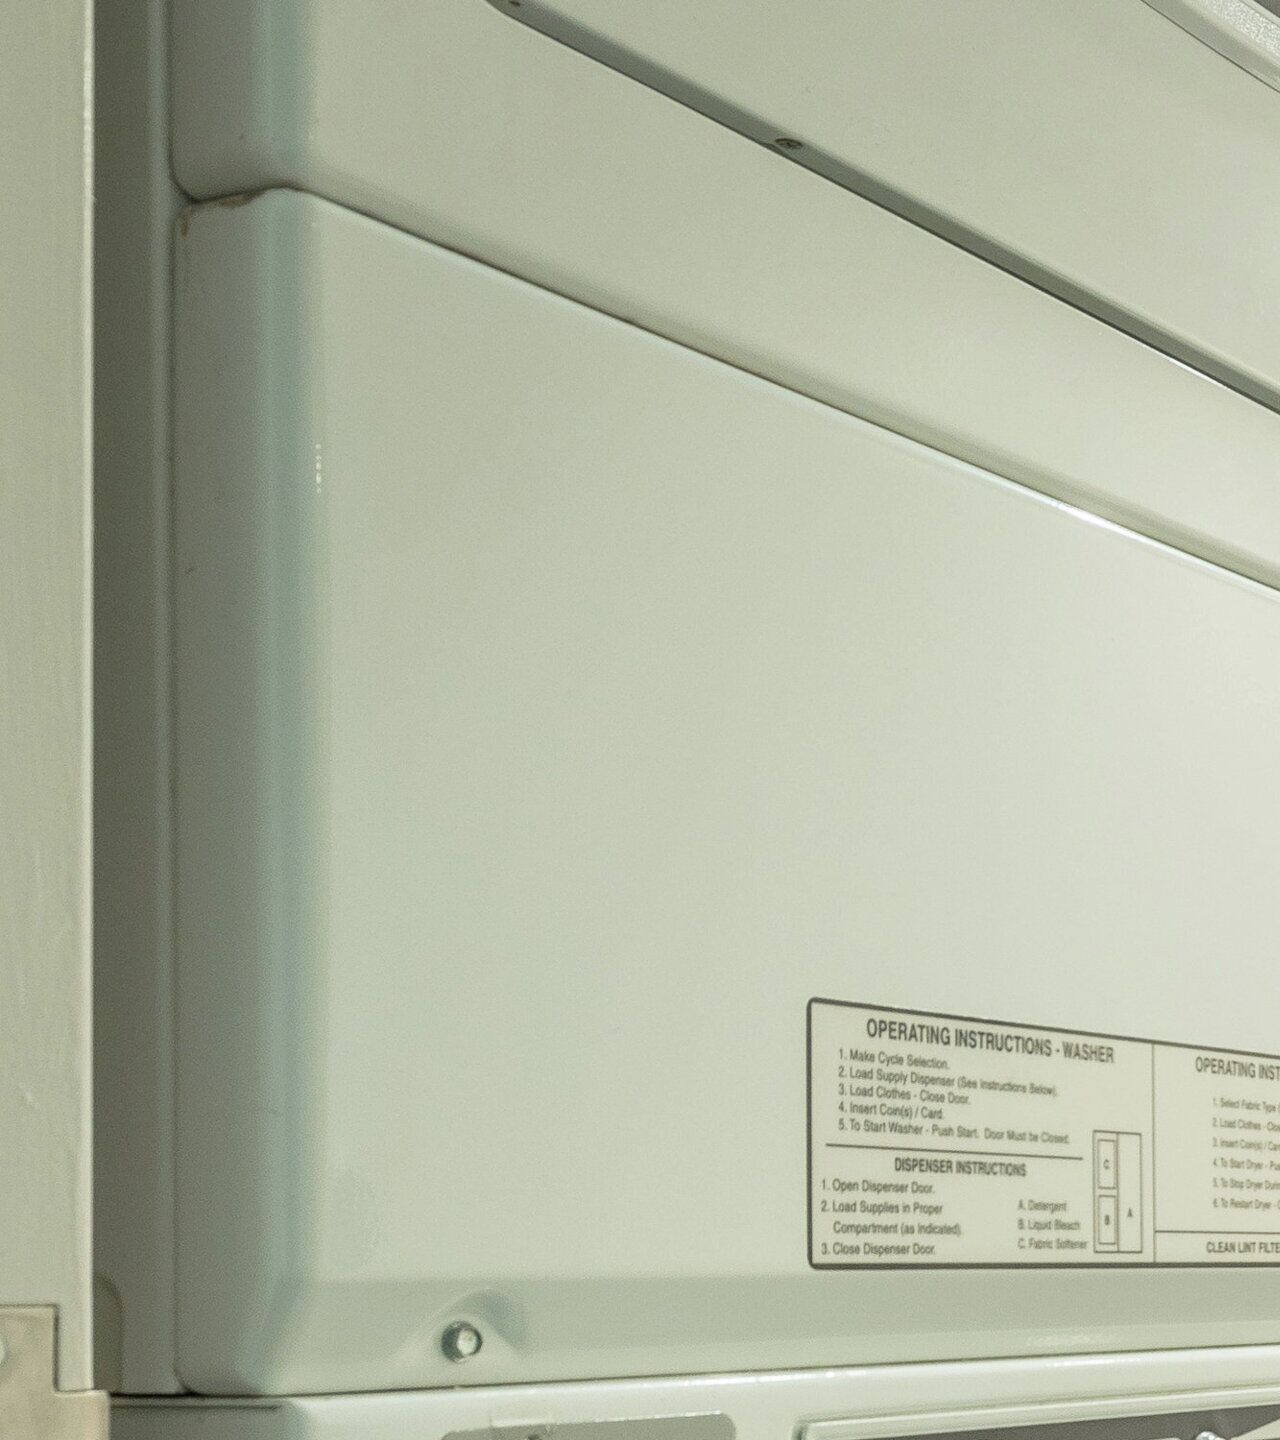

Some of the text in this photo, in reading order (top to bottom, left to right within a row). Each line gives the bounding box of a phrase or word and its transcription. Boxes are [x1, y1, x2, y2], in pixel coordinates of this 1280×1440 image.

[866, 1017, 1114, 1064] OPERATING INSTRUCTIONS WASHER
[1194, 1056, 1256, 1079] OPERATING
[893, 1156, 1026, 1176] DISPENSER INSTRUCTIONS
[1205, 1241, 1236, 1254] CLEAN
[1237, 1241, 1256, 1254] LINT
